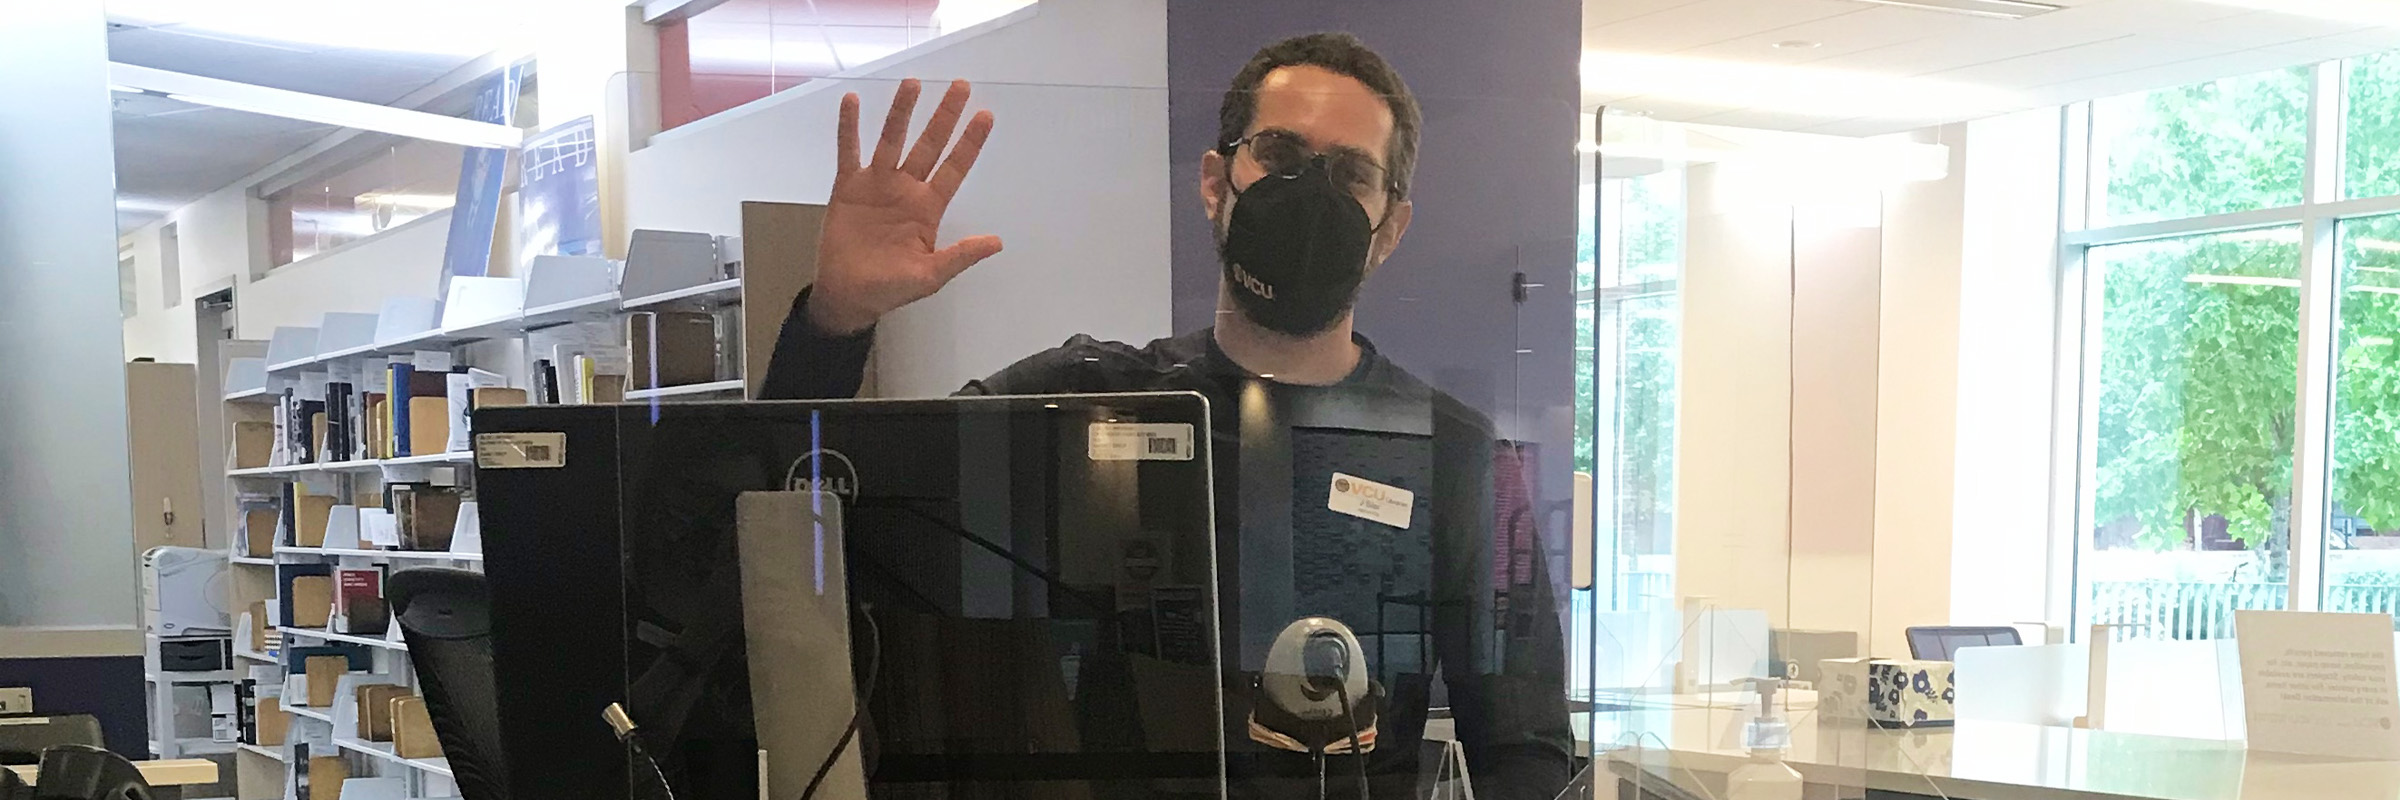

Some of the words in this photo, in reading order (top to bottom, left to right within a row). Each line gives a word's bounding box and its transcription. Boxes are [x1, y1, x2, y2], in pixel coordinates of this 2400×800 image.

[520, 129, 589, 187] READ
[1242, 269, 1273, 299] VCU
[1352, 482, 1386, 501] VCU
